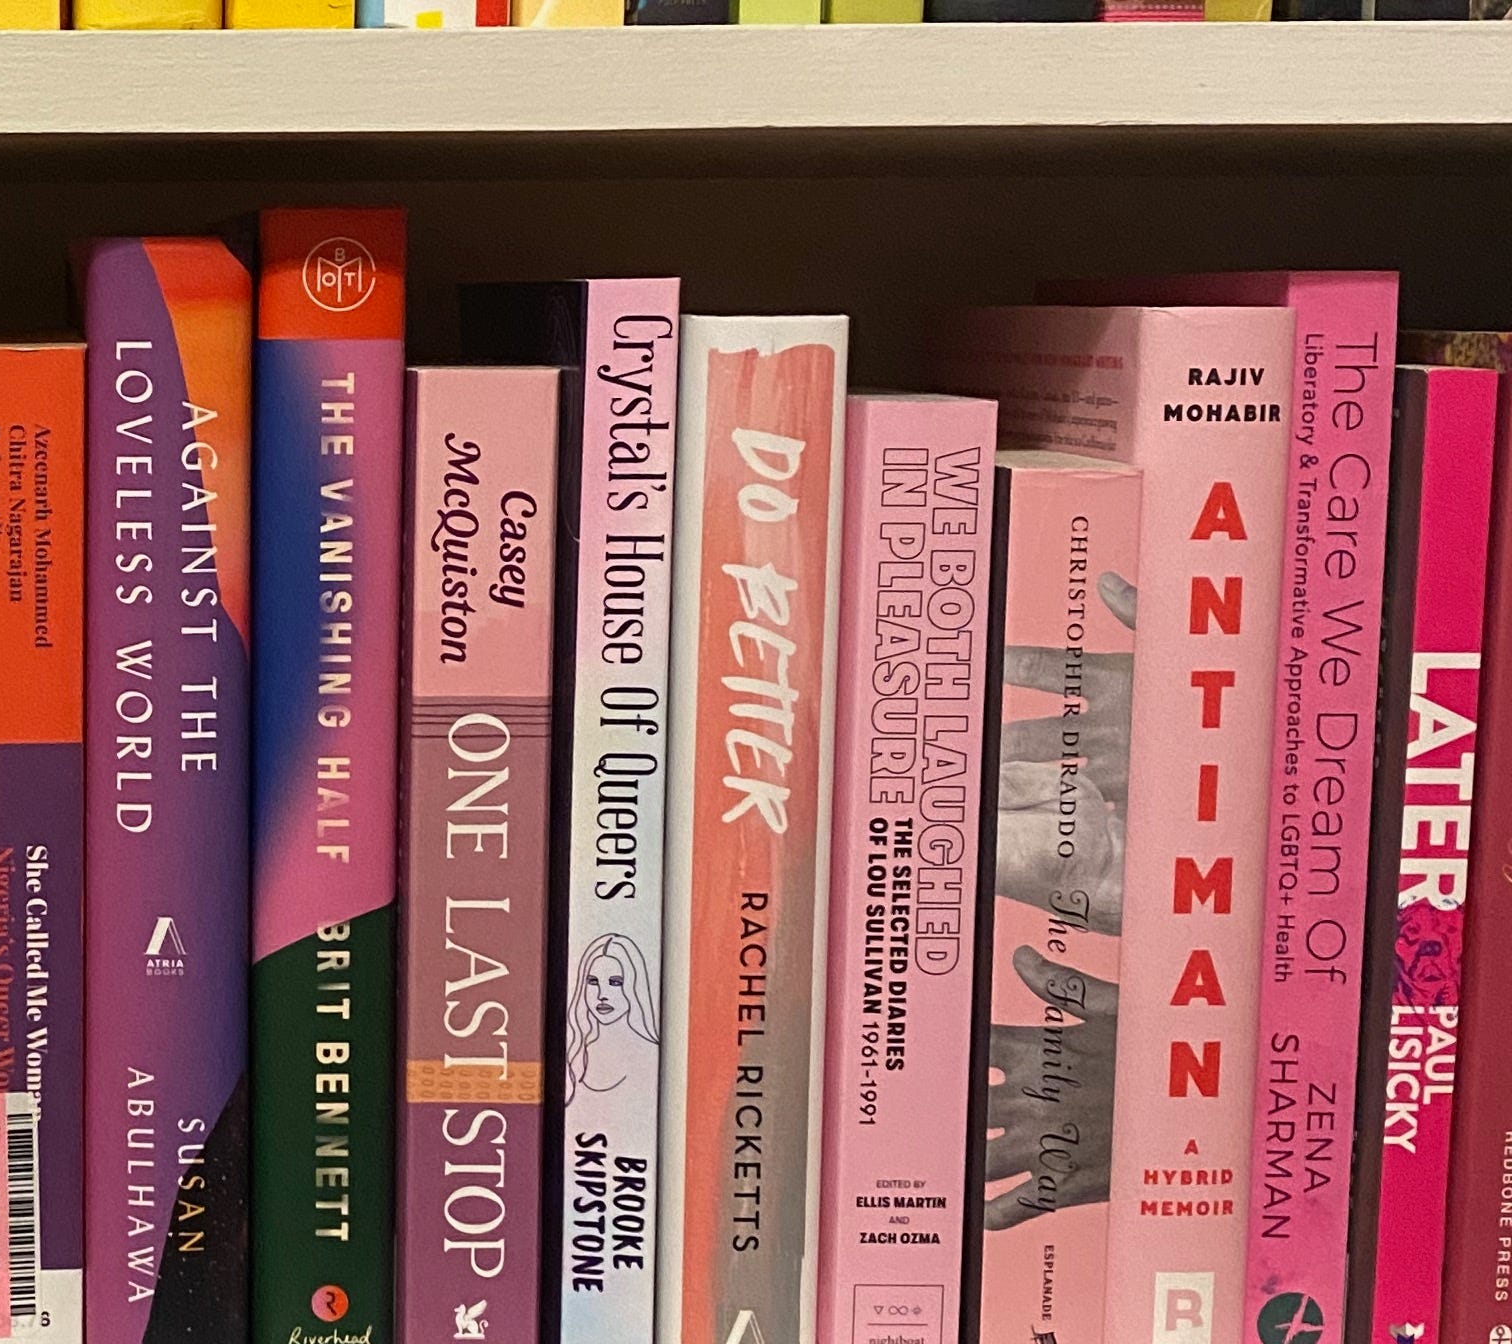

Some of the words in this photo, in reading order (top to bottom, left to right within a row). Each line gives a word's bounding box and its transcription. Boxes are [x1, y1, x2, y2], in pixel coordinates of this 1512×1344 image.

[1164, 405, 1281, 422] MOHABIR
[1189, 368, 1265, 386] RAJIV
[431, 432, 482, 664] McQuiston
[489, 490, 538, 609] Casey
[146, 958, 184, 968] ATRIA
[316, 920, 351, 1020] BRIT
[737, 891, 769, 1047] RACHEL
[128, 1067, 155, 1304] ABULHAWA
[315, 1043, 350, 1241] BENNETT
[732, 1066, 763, 1252] RICKETTS
[1143, 1169, 1233, 1186] HYBRID
[1261, 1034, 1300, 1239] SHARMAN
[1305, 1081, 1336, 1193] ZENA
[572, 1132, 607, 1294] SKIPSTONE
[612, 1157, 647, 1269] BROOKE
[856, 1196, 891, 1209] ELLIS
[894, 1196, 946, 1209] MARTIN
[860, 1233, 896, 1244] ZACH
[900, 1233, 940, 1244] OZMA
[1141, 1201, 1233, 1216] MEMOIR
[1042, 1245, 1055, 1320] ESPLANADE
